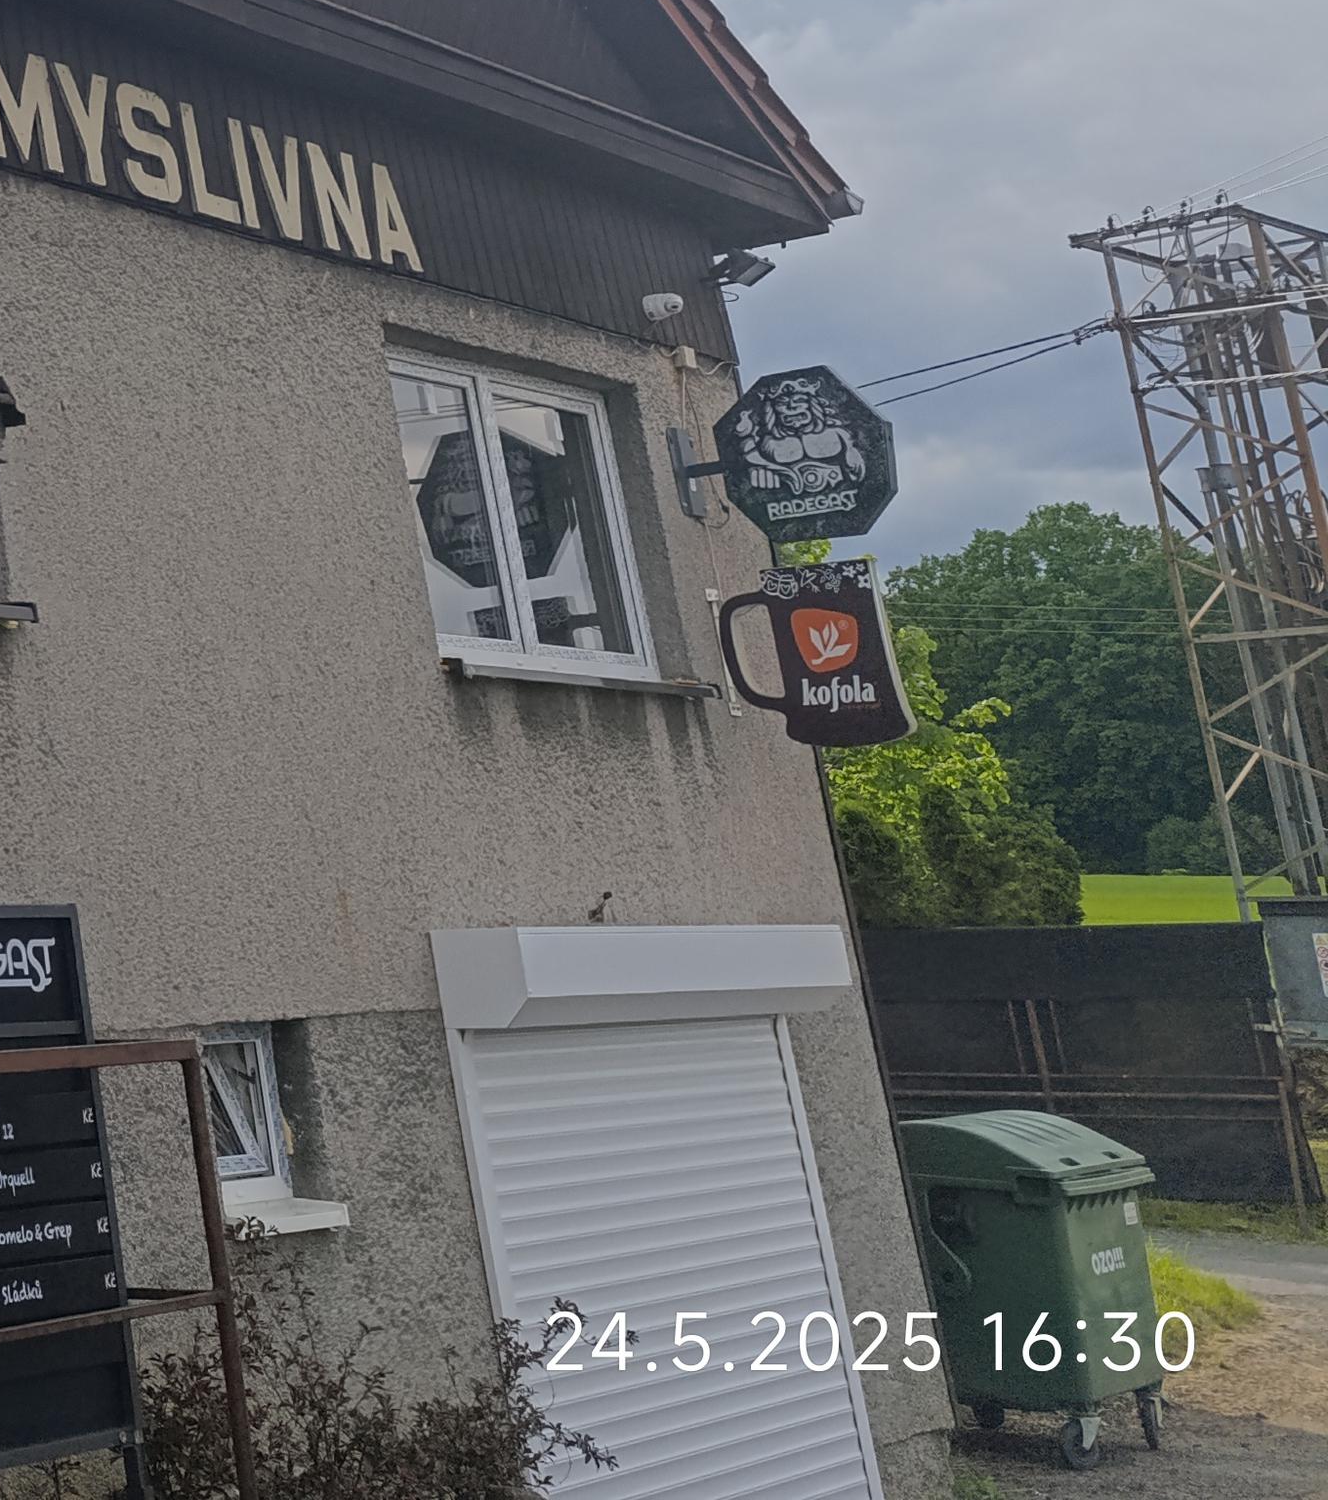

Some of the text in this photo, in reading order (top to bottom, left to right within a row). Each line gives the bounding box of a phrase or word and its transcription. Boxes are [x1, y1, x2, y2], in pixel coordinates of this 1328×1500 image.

[767, 488, 859, 522] RADEGAST
[801, 674, 876, 713] kofola
[82, 1107, 94, 1124] Kč
[2, 1123, 15, 1140] 12
[90, 1162, 102, 1179] Kč
[97, 1216, 110, 1234] Kč
[104, 1272, 117, 1290] Kč
